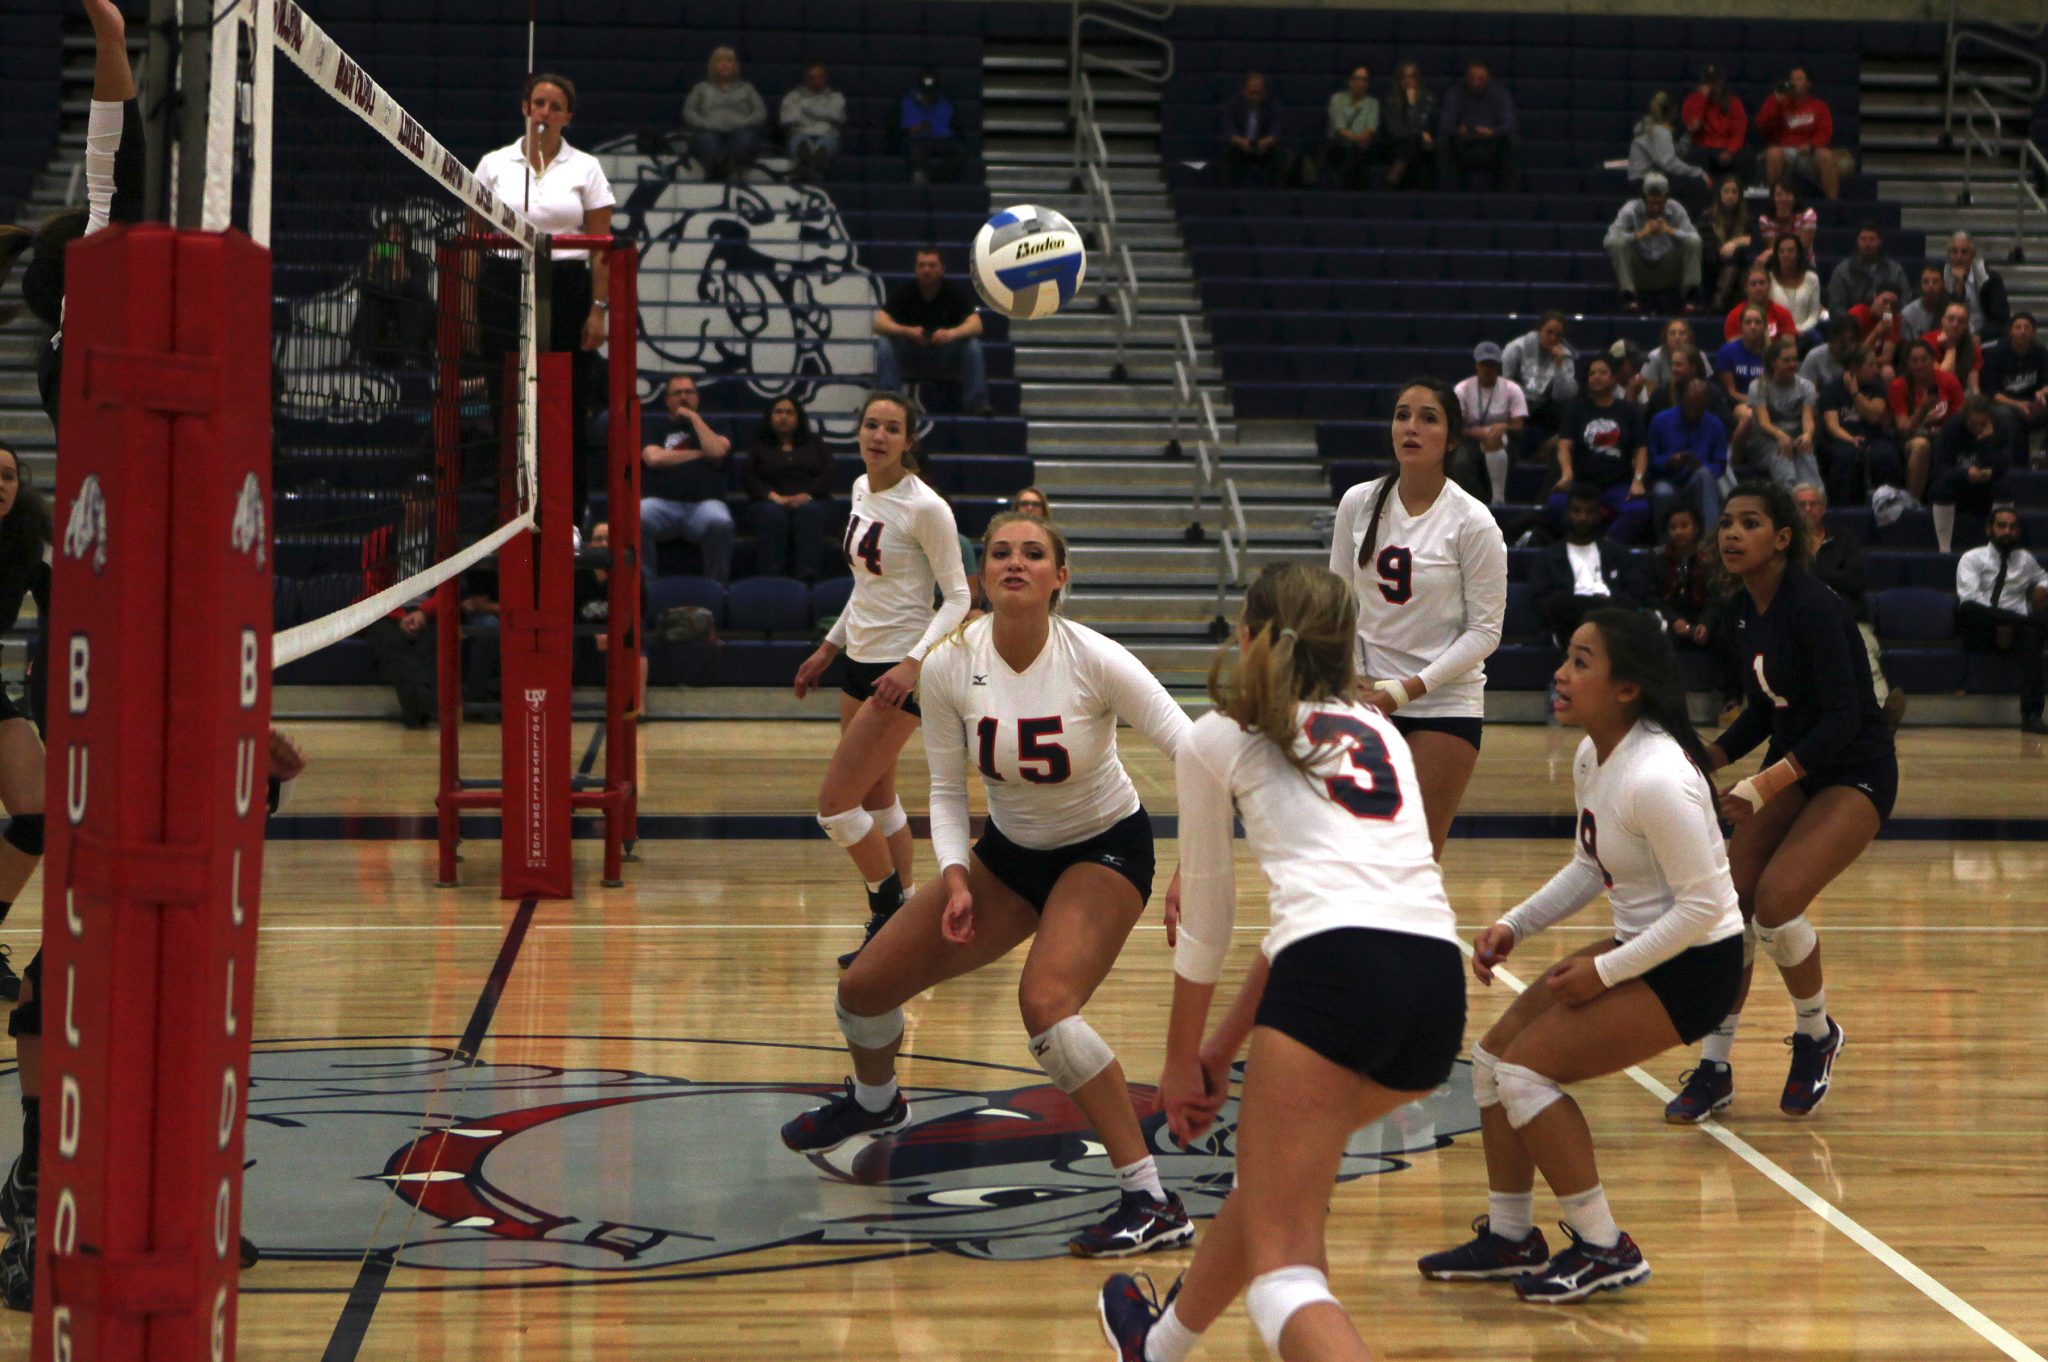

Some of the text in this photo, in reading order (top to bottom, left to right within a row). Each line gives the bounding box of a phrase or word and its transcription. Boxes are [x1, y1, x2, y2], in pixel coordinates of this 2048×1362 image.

[844, 513, 884, 576] 14
[1376, 544, 1413, 606] 9
[1752, 652, 1789, 708] 1
[976, 715, 1071, 784] 15
[1303, 711, 1403, 823] 3
